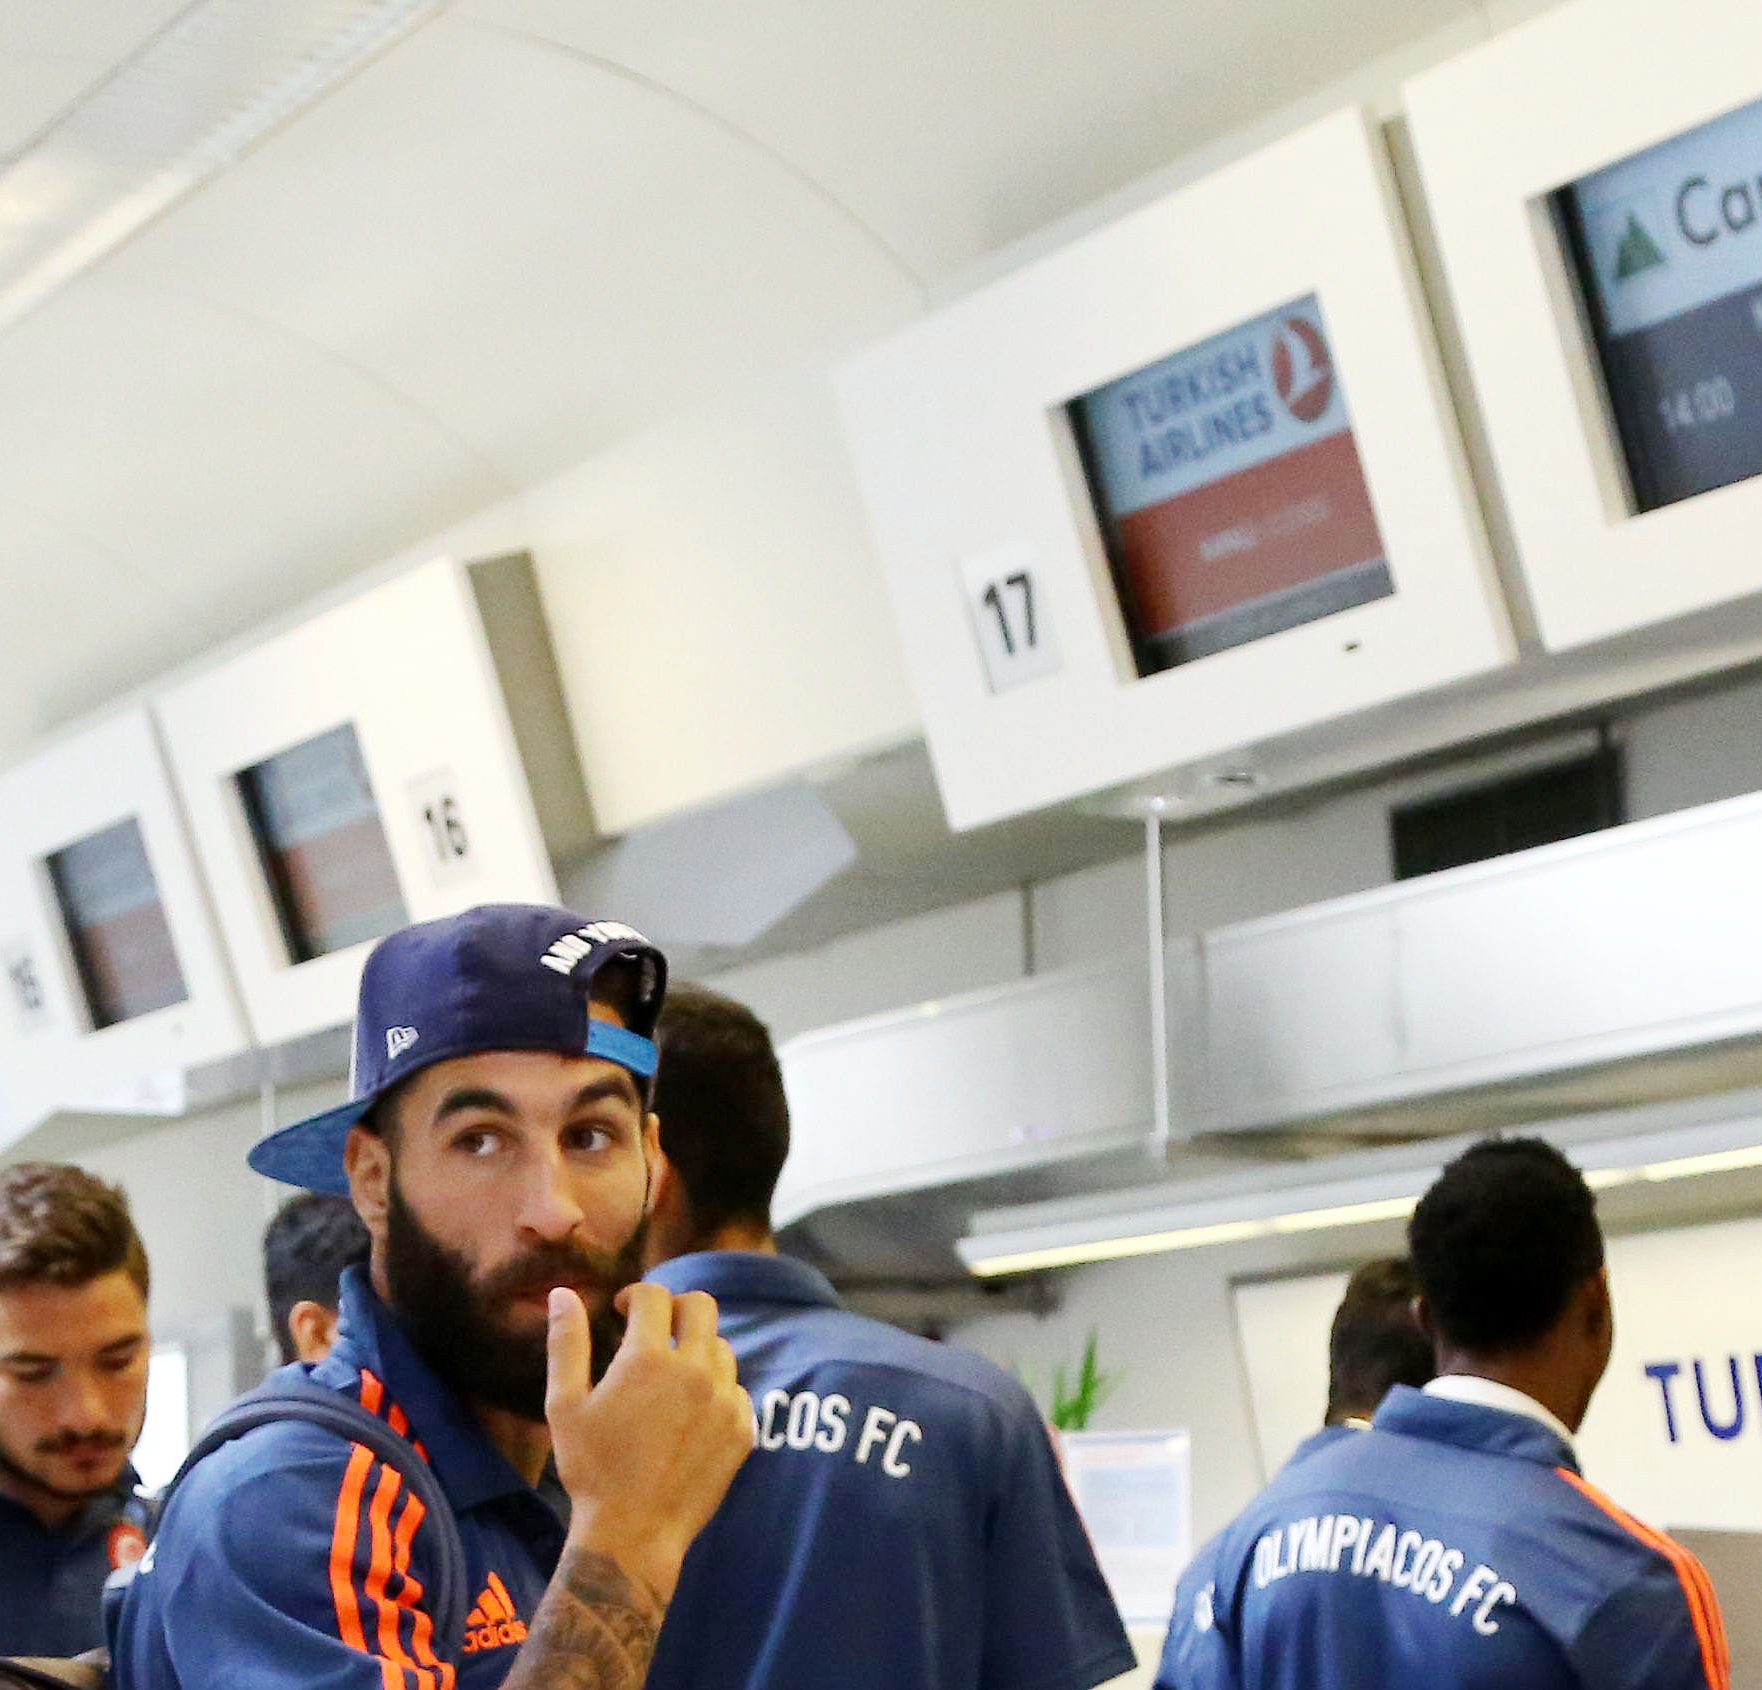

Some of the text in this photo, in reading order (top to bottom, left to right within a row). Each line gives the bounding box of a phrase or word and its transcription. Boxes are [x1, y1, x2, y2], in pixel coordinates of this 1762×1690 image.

[983, 572, 1037, 654] 17
[422, 796, 469, 862] 16
[752, 1387, 923, 1478] COS FC
[1253, 1513, 1517, 1635] OLYMPIACOS FC
